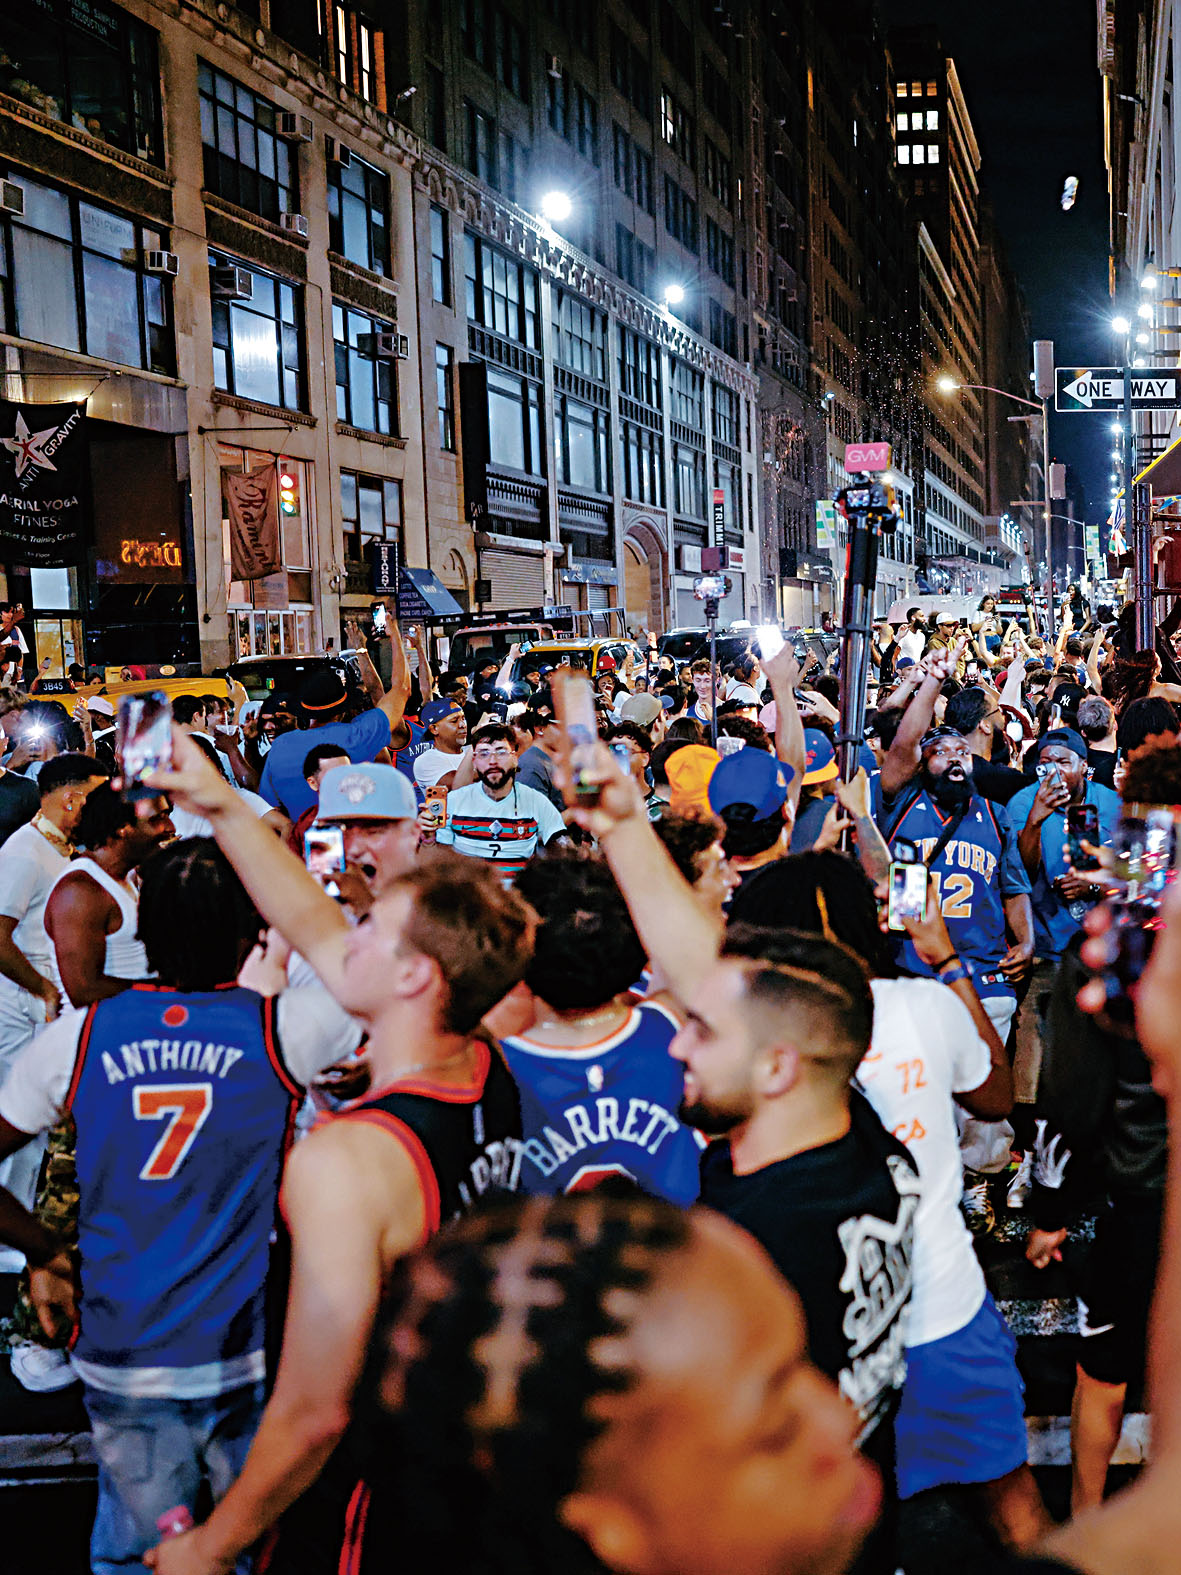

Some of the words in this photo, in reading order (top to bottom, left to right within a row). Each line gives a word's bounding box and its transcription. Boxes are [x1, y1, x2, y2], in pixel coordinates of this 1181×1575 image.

[1077, 382, 1112, 397] ONE
[1130, 382, 1168, 397] WAY
[44, 409, 80, 456] GRAVITY
[848, 449, 885, 463] GVM
[19, 466, 40, 492] ANTI
[43, 496, 78, 510] YOGA
[14, 514, 62, 528] FITNES
[715, 506, 724, 546] TRIMMI
[42, 682, 63, 691] 3B45
[489, 844, 501, 857] 7
[101, 1039, 244, 1085] ANTHONY
[895, 1058, 928, 1094] 72
[132, 1082, 213, 1180] 7
[522, 1097, 679, 1177] BARRETT
